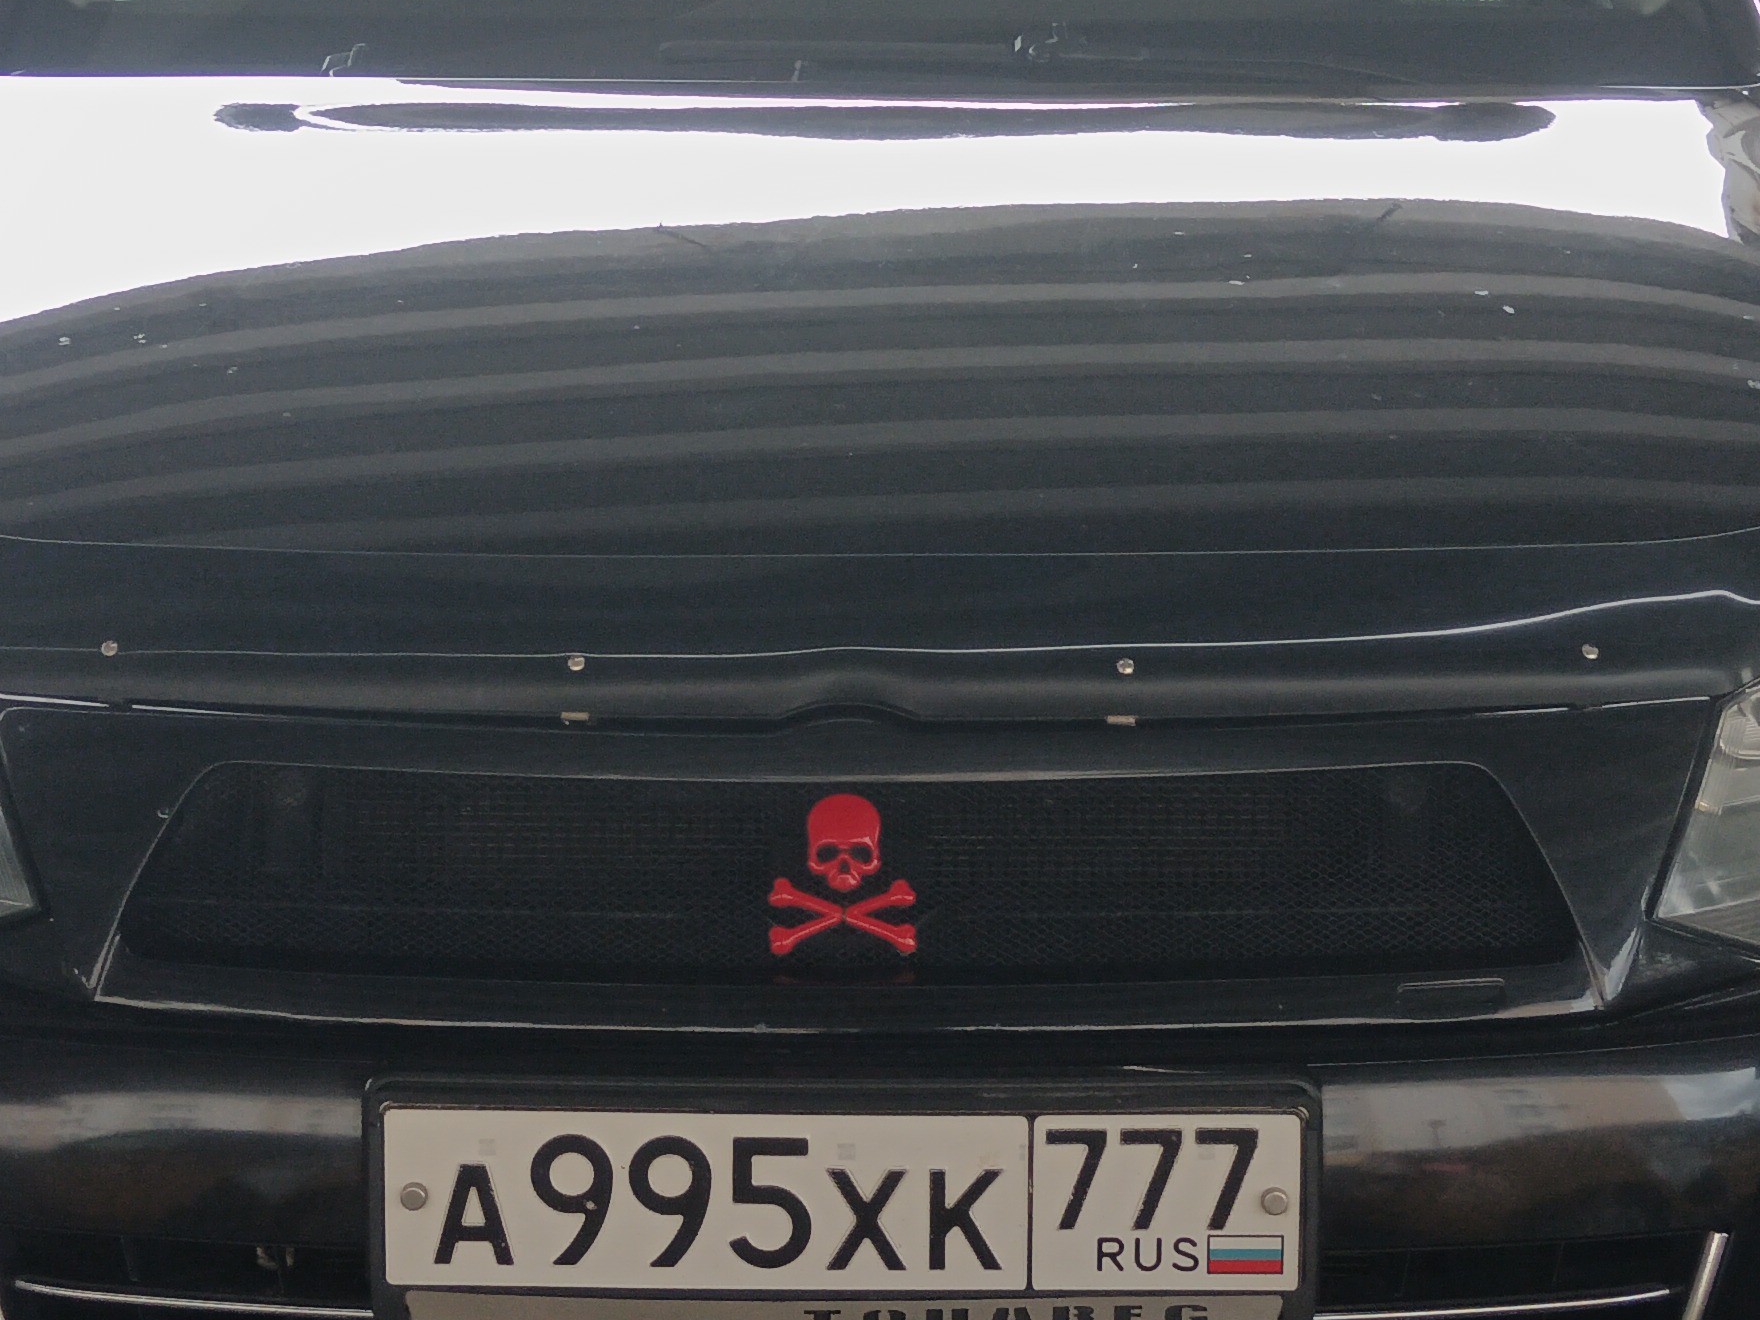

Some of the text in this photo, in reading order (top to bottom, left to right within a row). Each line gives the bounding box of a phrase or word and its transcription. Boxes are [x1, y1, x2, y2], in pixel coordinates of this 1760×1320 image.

[432, 1128, 1261, 1272] А995ХК 777
[1096, 1236, 1200, 1273] RUS
